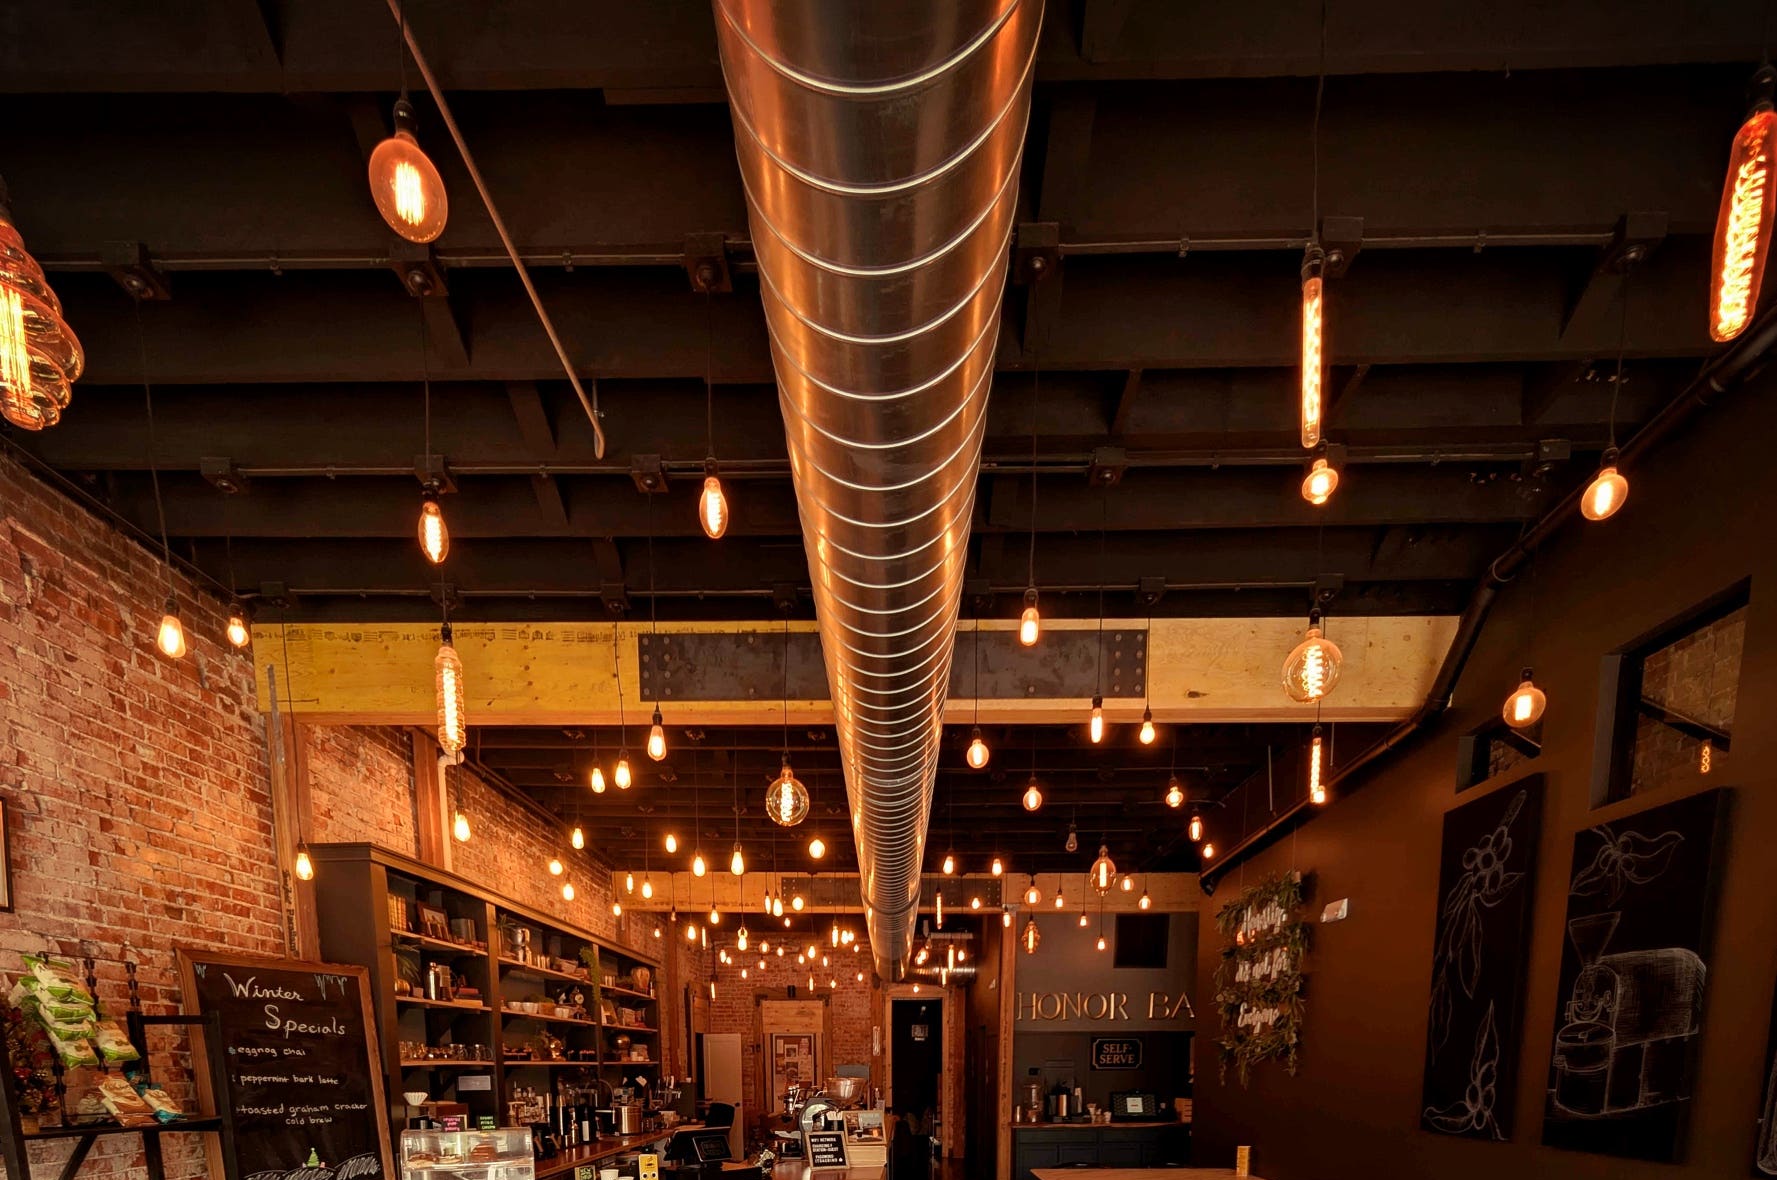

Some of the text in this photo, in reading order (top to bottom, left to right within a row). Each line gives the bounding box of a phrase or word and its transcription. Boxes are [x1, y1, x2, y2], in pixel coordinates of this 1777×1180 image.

[223, 972, 304, 1001] Winter
[1016, 992, 1129, 1020] HONOR
[264, 1004, 346, 1039] Specials
[237, 1046, 306, 1057] eggnog chai
[1102, 1043, 1133, 1054] SELF-
[1099, 1054, 1136, 1064] SERVE
[239, 1074, 339, 1086] peppermint bark latte
[240, 1103, 285, 1115] toasted
[289, 1103, 329, 1117] graham
[285, 1116, 333, 1125] cold brew
